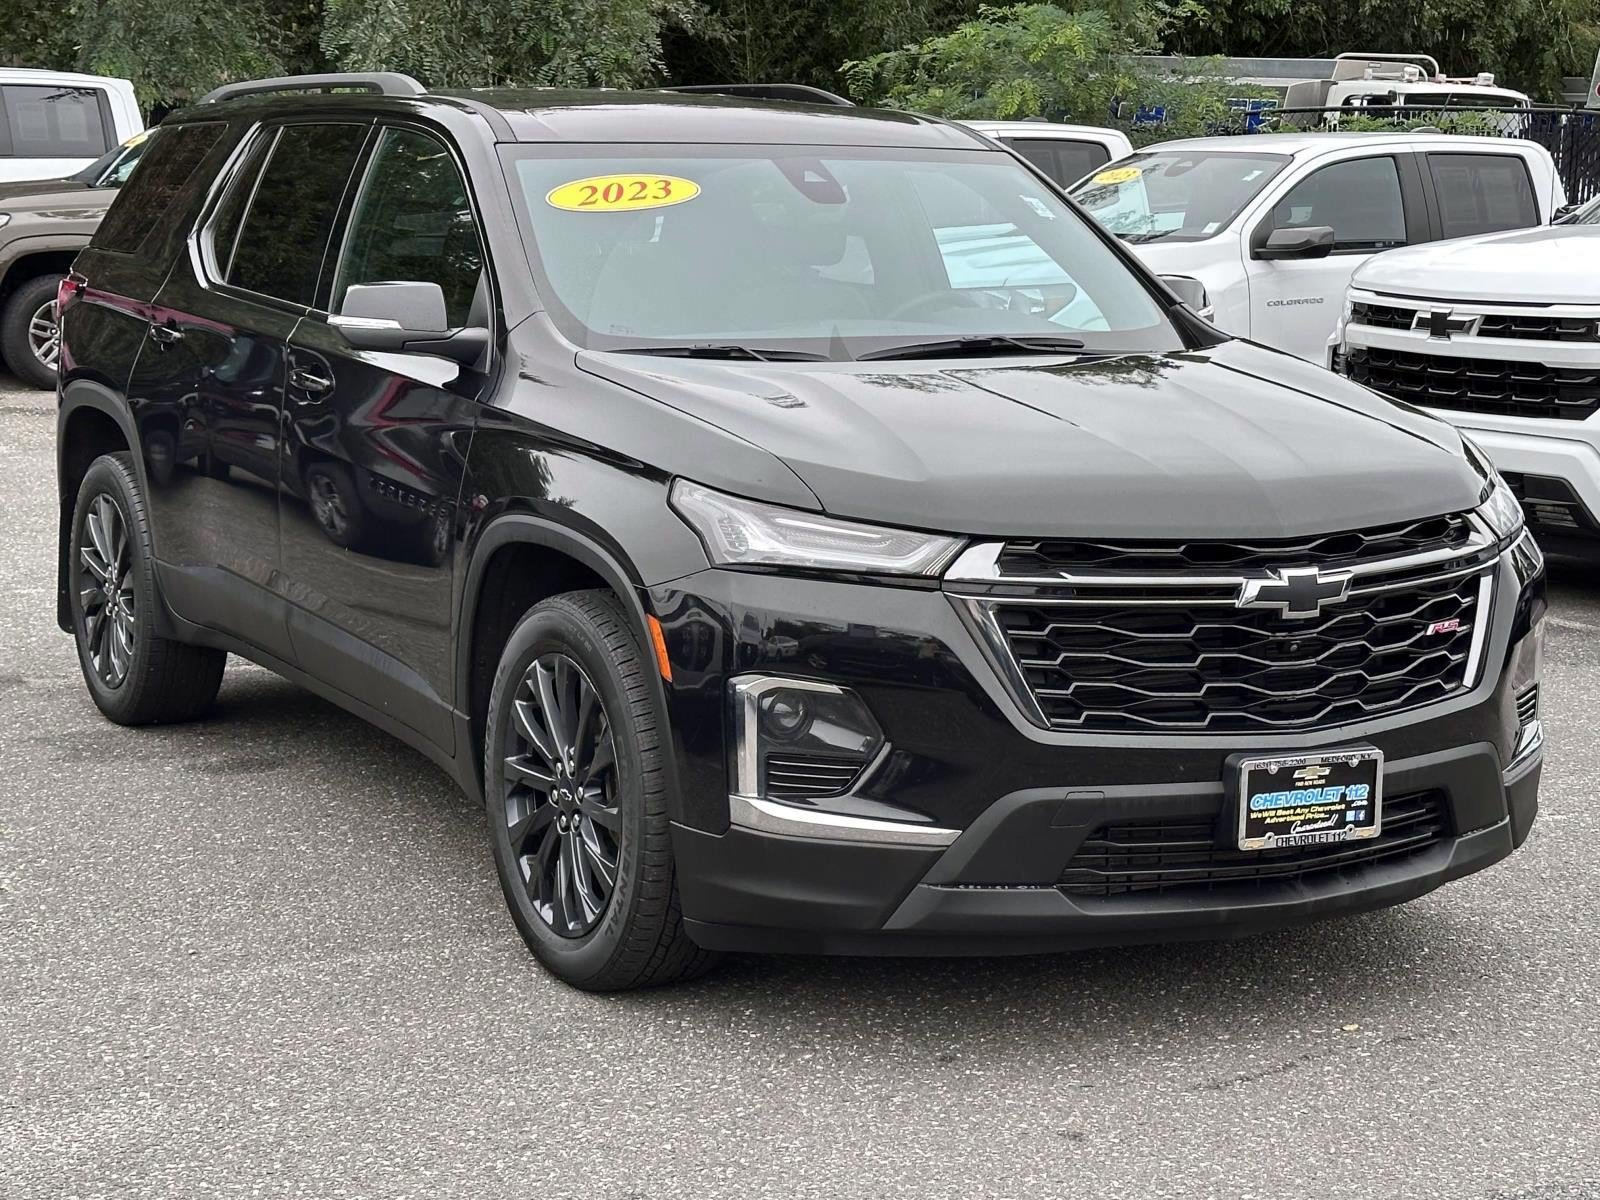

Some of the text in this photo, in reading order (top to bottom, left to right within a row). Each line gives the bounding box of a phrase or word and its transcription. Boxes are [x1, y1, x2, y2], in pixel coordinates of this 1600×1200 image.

[577, 179, 672, 207] 2023
[1266, 297, 1324, 307] COLORADO
[1427, 619, 1460, 636] RS
[1251, 784, 1369, 810] CHEVROLET 112
[1295, 807, 1310, 815] Any
[1310, 803, 1346, 812] Chevrolet
[1276, 831, 1347, 847] CHEVROLET 112
